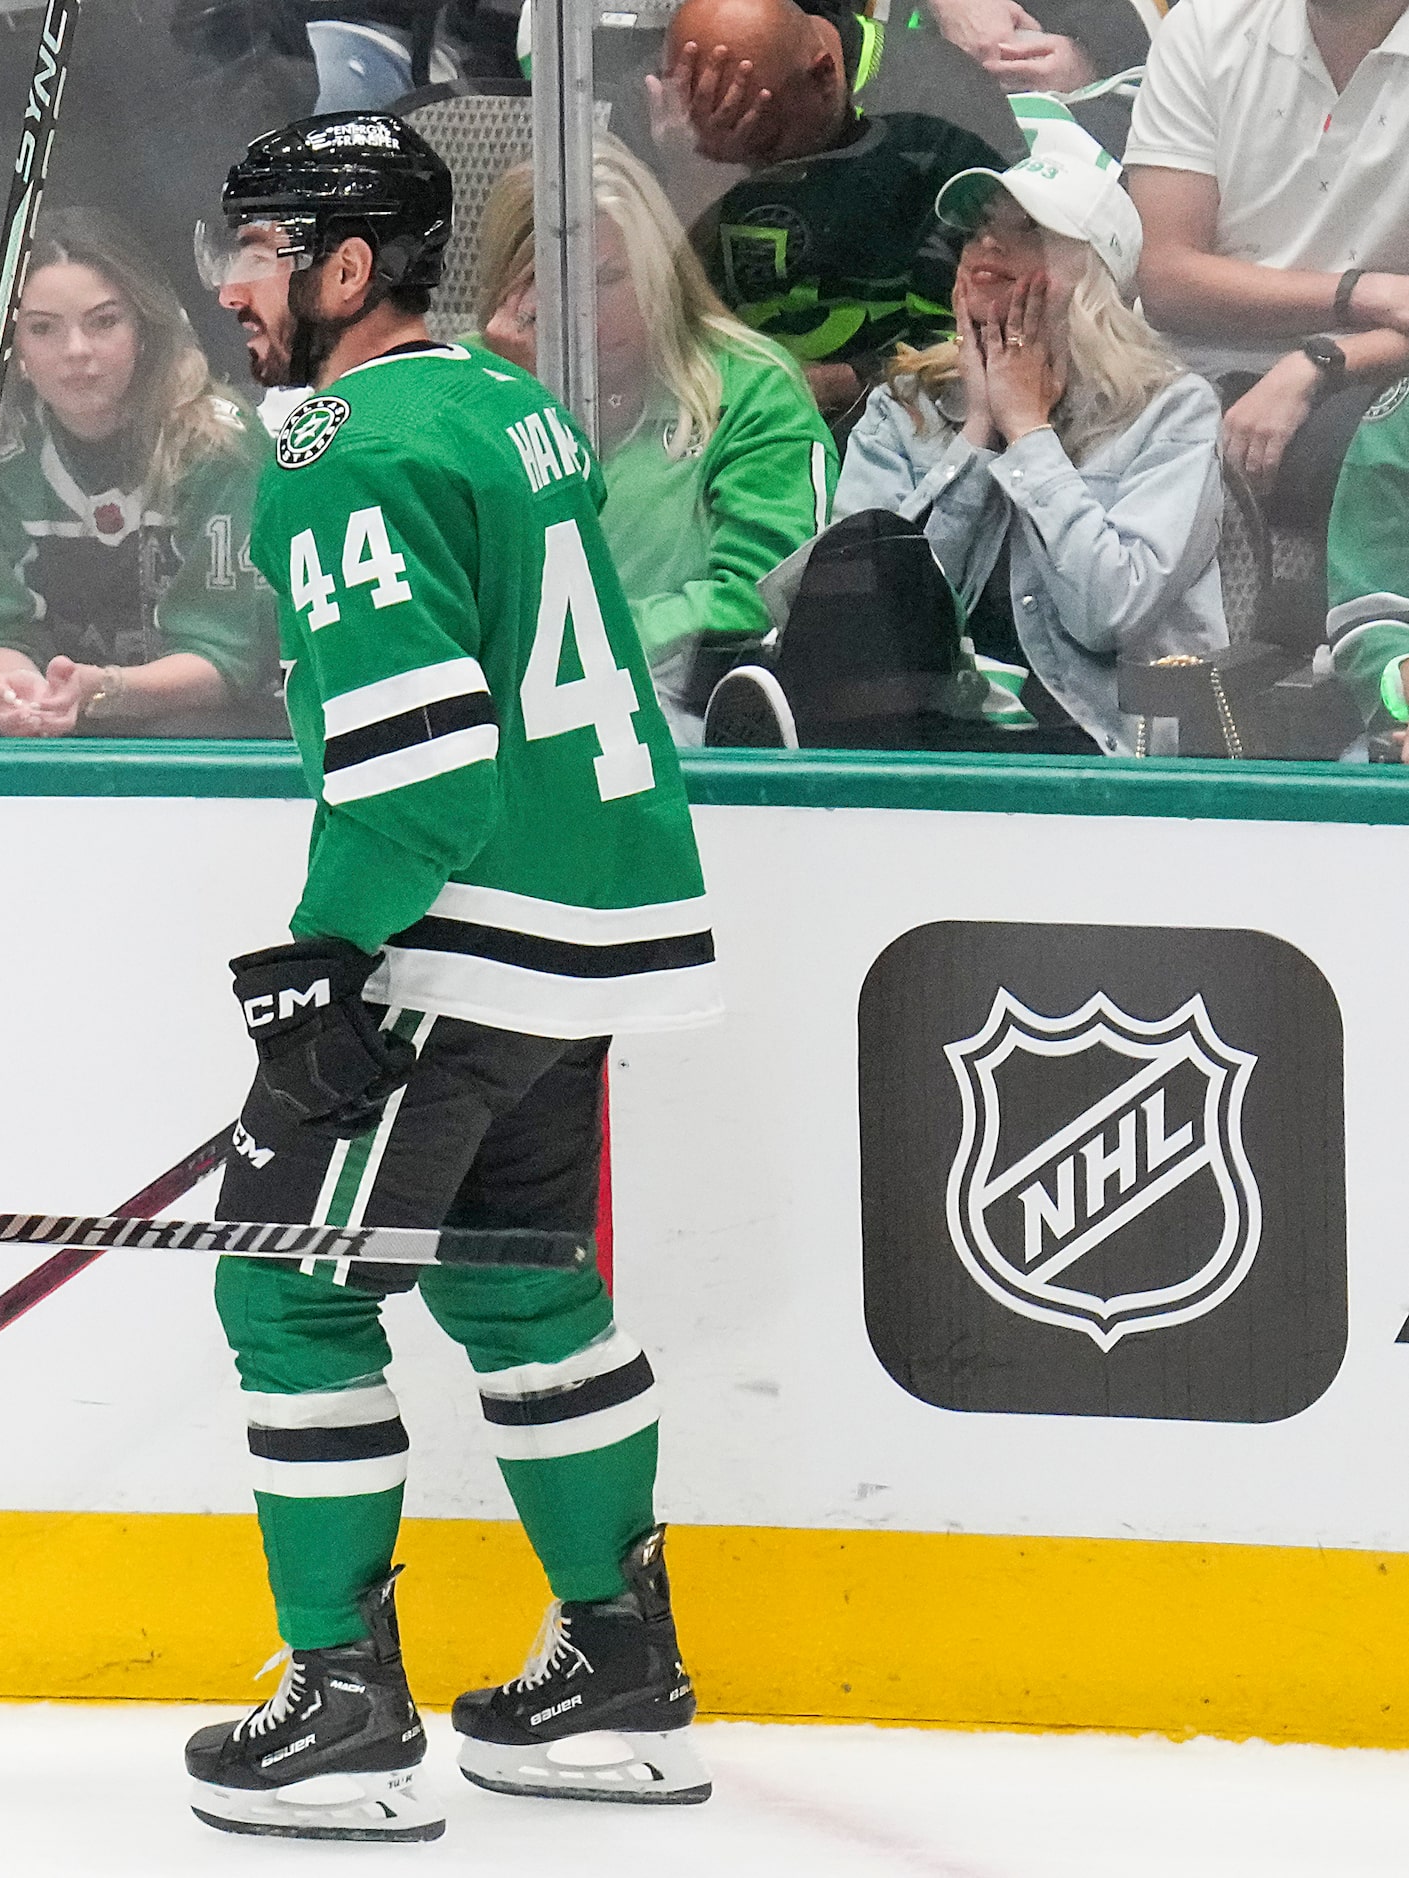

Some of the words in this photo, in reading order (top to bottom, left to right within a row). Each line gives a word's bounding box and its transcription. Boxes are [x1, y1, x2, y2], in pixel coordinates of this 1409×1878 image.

[333, 122, 392, 136] ENERGY
[334, 134, 400, 150] TRANSFER
[289, 505, 412, 632] 44
[520, 518, 656, 802] 4
[1018, 1087, 1194, 1265] NHL
[329, 1679, 367, 1694] MACH
[529, 1694, 583, 1727] BAUER
[260, 1733, 316, 1768] BAUER
